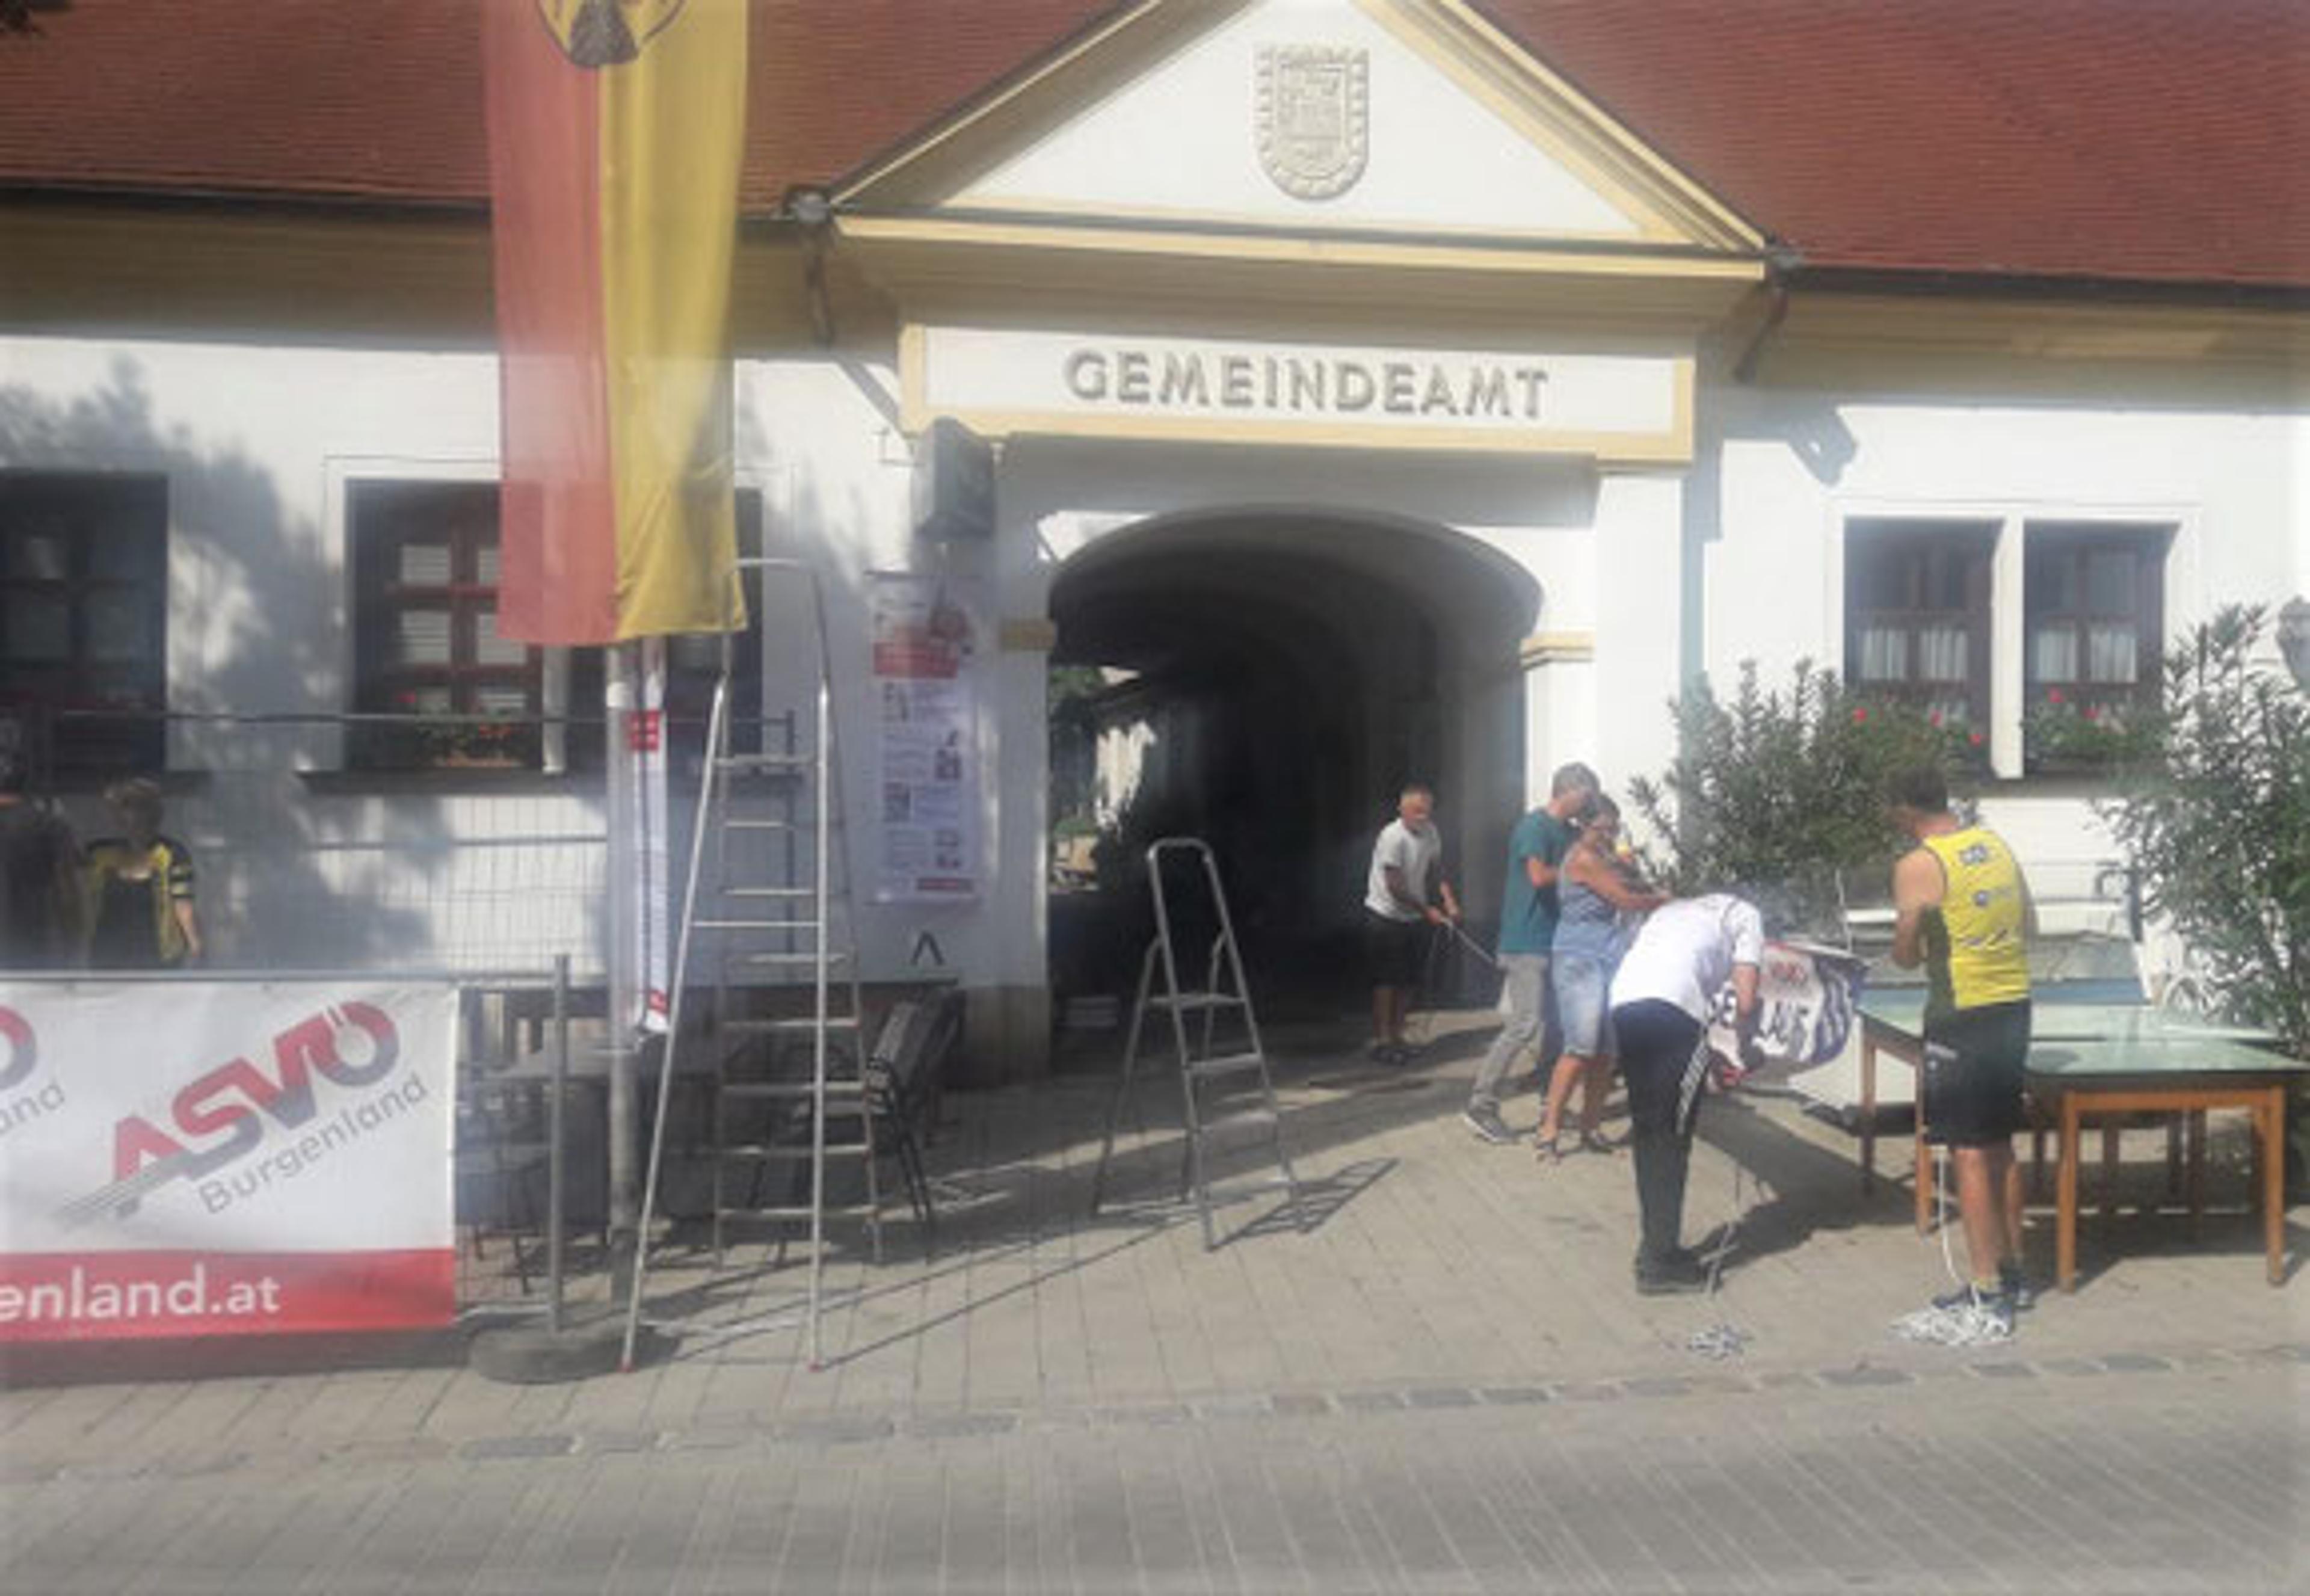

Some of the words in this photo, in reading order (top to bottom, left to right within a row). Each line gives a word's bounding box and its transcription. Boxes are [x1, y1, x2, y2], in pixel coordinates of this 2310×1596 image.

[1064, 349, 1550, 420] GEMEINDEAMT
[197, 1071, 427, 1215] Burgenland
[0, 1262, 281, 1320] enland.at
